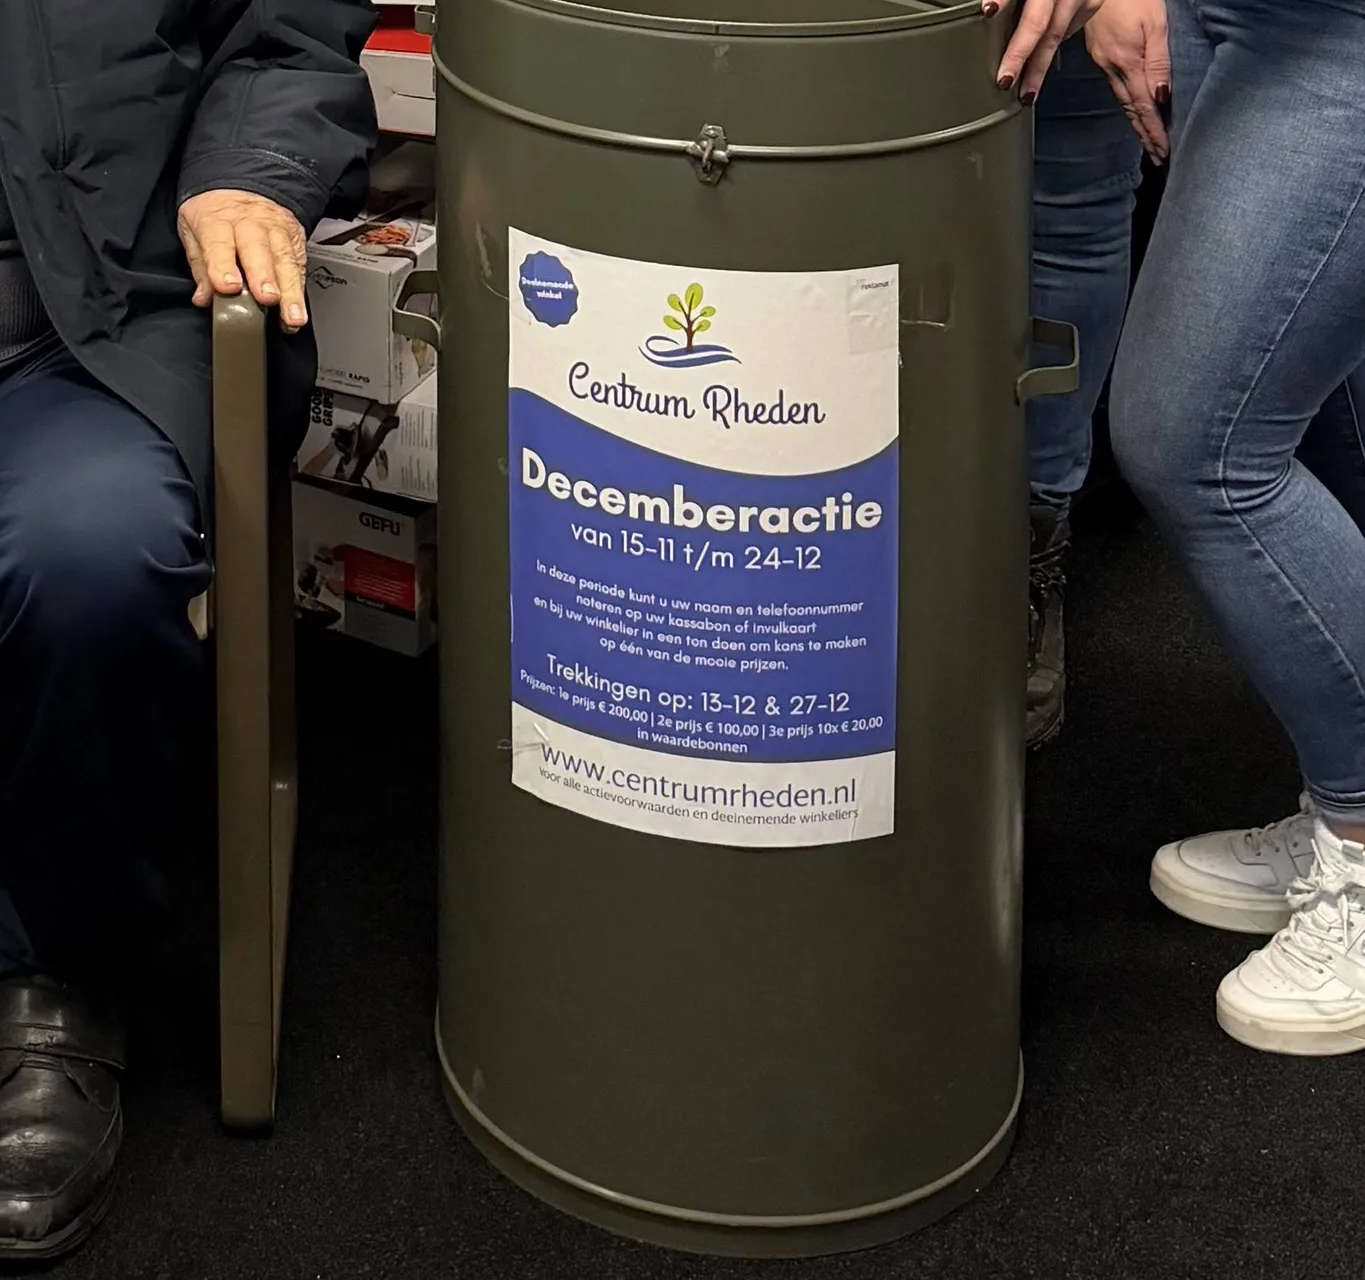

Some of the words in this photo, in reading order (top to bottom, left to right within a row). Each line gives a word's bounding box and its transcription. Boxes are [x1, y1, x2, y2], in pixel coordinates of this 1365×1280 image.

[568, 361, 696, 419] Centrum
[703, 384, 827, 429] Rheden
[522, 447, 883, 534] Decemberactie
[359, 511, 401, 536] GEFU
[571, 523, 612, 550] van
[621, 530, 674, 562] 15-11
[683, 541, 734, 571] t/m
[744, 546, 822, 570] 24-12
[536, 559, 547, 574] In
[548, 566, 576, 585] deze
[579, 578, 626, 600] periode
[629, 588, 656, 605] kunt
[659, 598, 668, 607] u
[671, 600, 691, 611] uw
[694, 602, 732, 615] naam
[736, 606, 753, 616] en
[757, 602, 864, 616] telefoonnummer
[576, 595, 622, 616] noteren
[625, 609, 642, 623] op
[645, 613, 665, 624] uw
[668, 613, 731, 632] kassabon
[734, 620, 750, 634] of
[752, 621, 817, 634] invulkaart
[533, 596, 547, 610] en
[549, 600, 563, 619] bij
[565, 609, 583, 622] uw
[585, 615, 639, 637] winkelier
[642, 628, 654, 641] in
[657, 632, 682, 645] een
[686, 633, 708, 648] ton
[711, 637, 746, 651] doen
[749, 642, 771, 652] om
[774, 639, 805, 652] kans
[808, 640, 821, 651] te
[825, 635, 867, 650] maken
[599, 637, 616, 651] op
[646, 648, 670, 661] van
[673, 650, 691, 665] de
[695, 655, 737, 669] mooie
[740, 657, 789, 673] prijzen.
[520, 669, 556, 696] Prijzen:
[559, 687, 570, 701] 1e
[572, 695, 596, 712] prijs
[608, 704, 649, 723] 200,00
[657, 714, 673, 728] 2e
[675, 720, 703, 733] prijs
[718, 722, 759, 738] 100,00
[768, 725, 785, 737] 3e
[787, 724, 814, 739] prijs
[818, 722, 839, 734] 10x
[851, 716, 884, 732] 20,00
[547, 653, 651, 703] Trekkingen
[657, 691, 693, 714] op:
[700, 691, 756, 716] 13-12
[764, 695, 781, 716] &
[790, 692, 851, 715] 27-12
[637, 727, 649, 742] in
[651, 732, 748, 753] waardebonnen
[539, 766, 562, 782] voor
[563, 776, 581, 791] alle
[583, 786, 690, 818] actievoorwaarden
[693, 809, 708, 820] en
[711, 810, 796, 825] deelnemende
[799, 808, 859, 824] winkeliers
[541, 742, 856, 808] www.centrumrheden.nl
